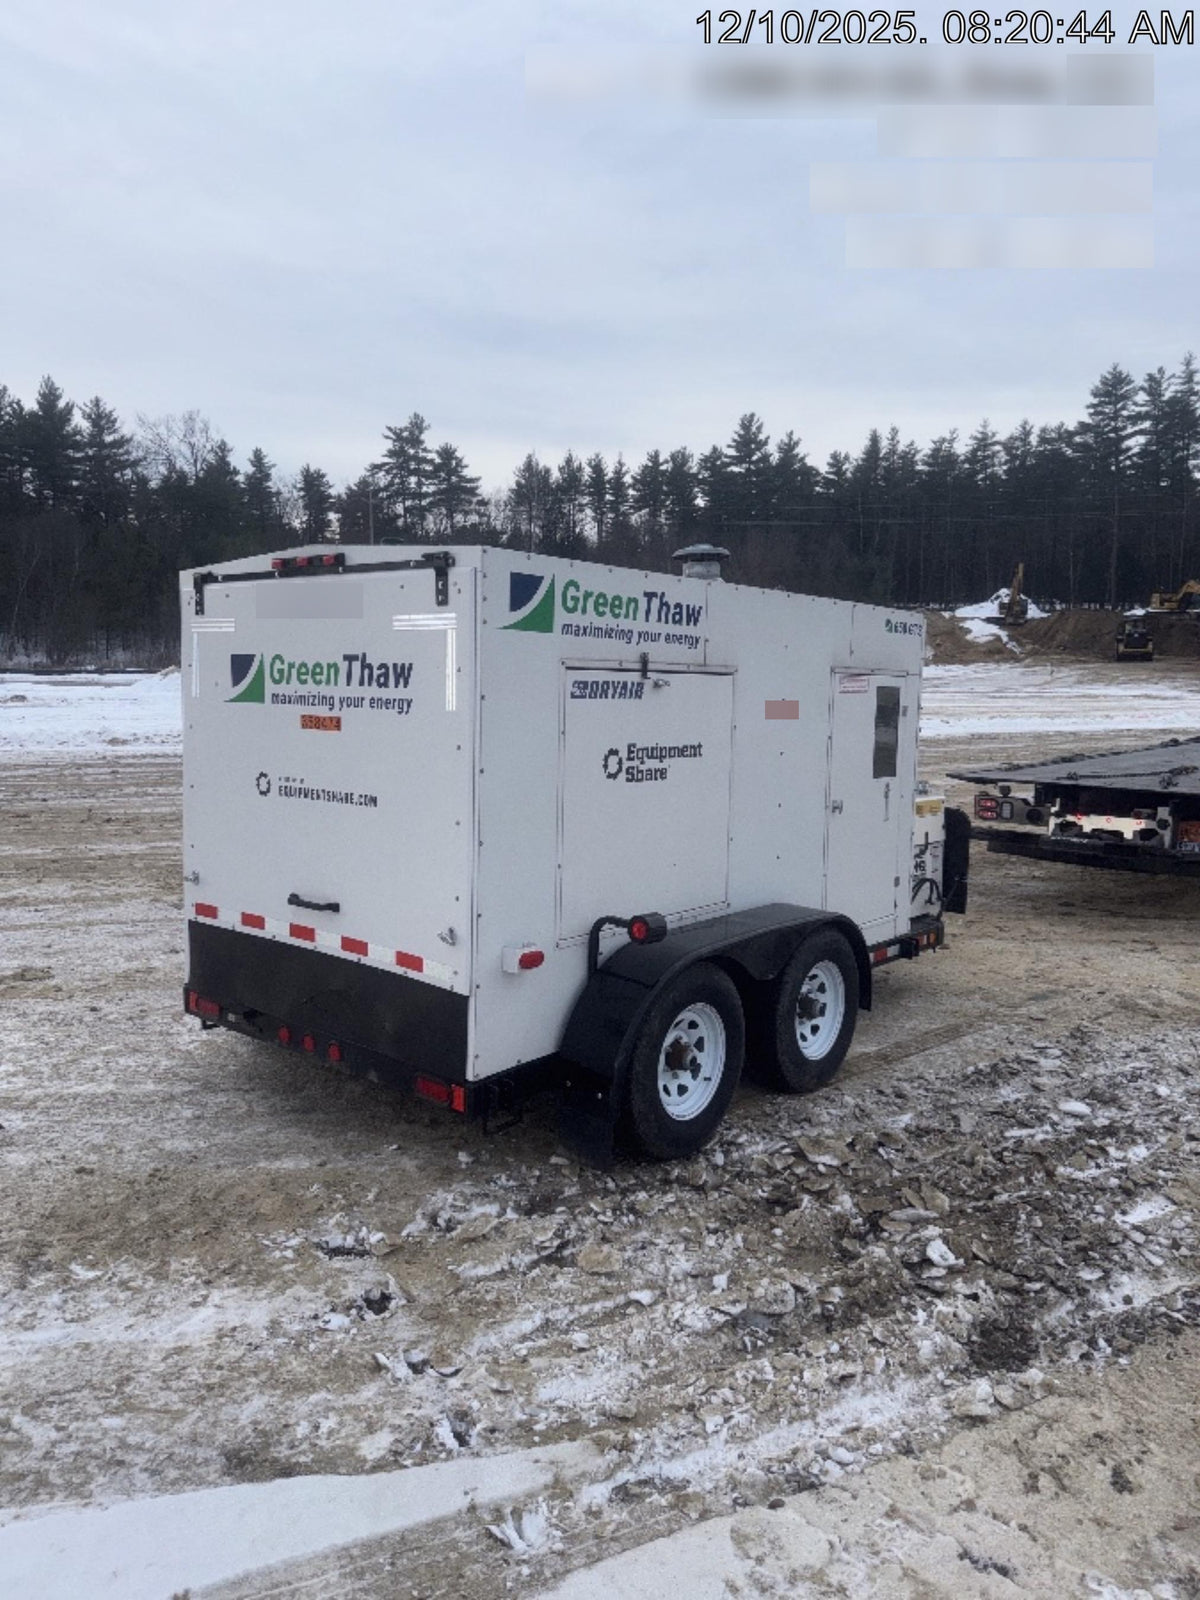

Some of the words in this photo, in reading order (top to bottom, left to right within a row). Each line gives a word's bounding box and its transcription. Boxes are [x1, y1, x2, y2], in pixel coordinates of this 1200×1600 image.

[561, 579, 703, 627] GreenThaw
[561, 622, 634, 645] maximizing
[636, 630, 661, 646] your
[664, 633, 702, 650] energy
[269, 652, 413, 688] GreenThaw
[271, 691, 335, 711] maximizing
[339, 694, 365, 711] your
[369, 696, 413, 715] energy
[626, 742, 703, 764] Equipment
[626, 765, 667, 783] Share
[278, 785, 378, 808] EQUIPMENTSHARE.COM
